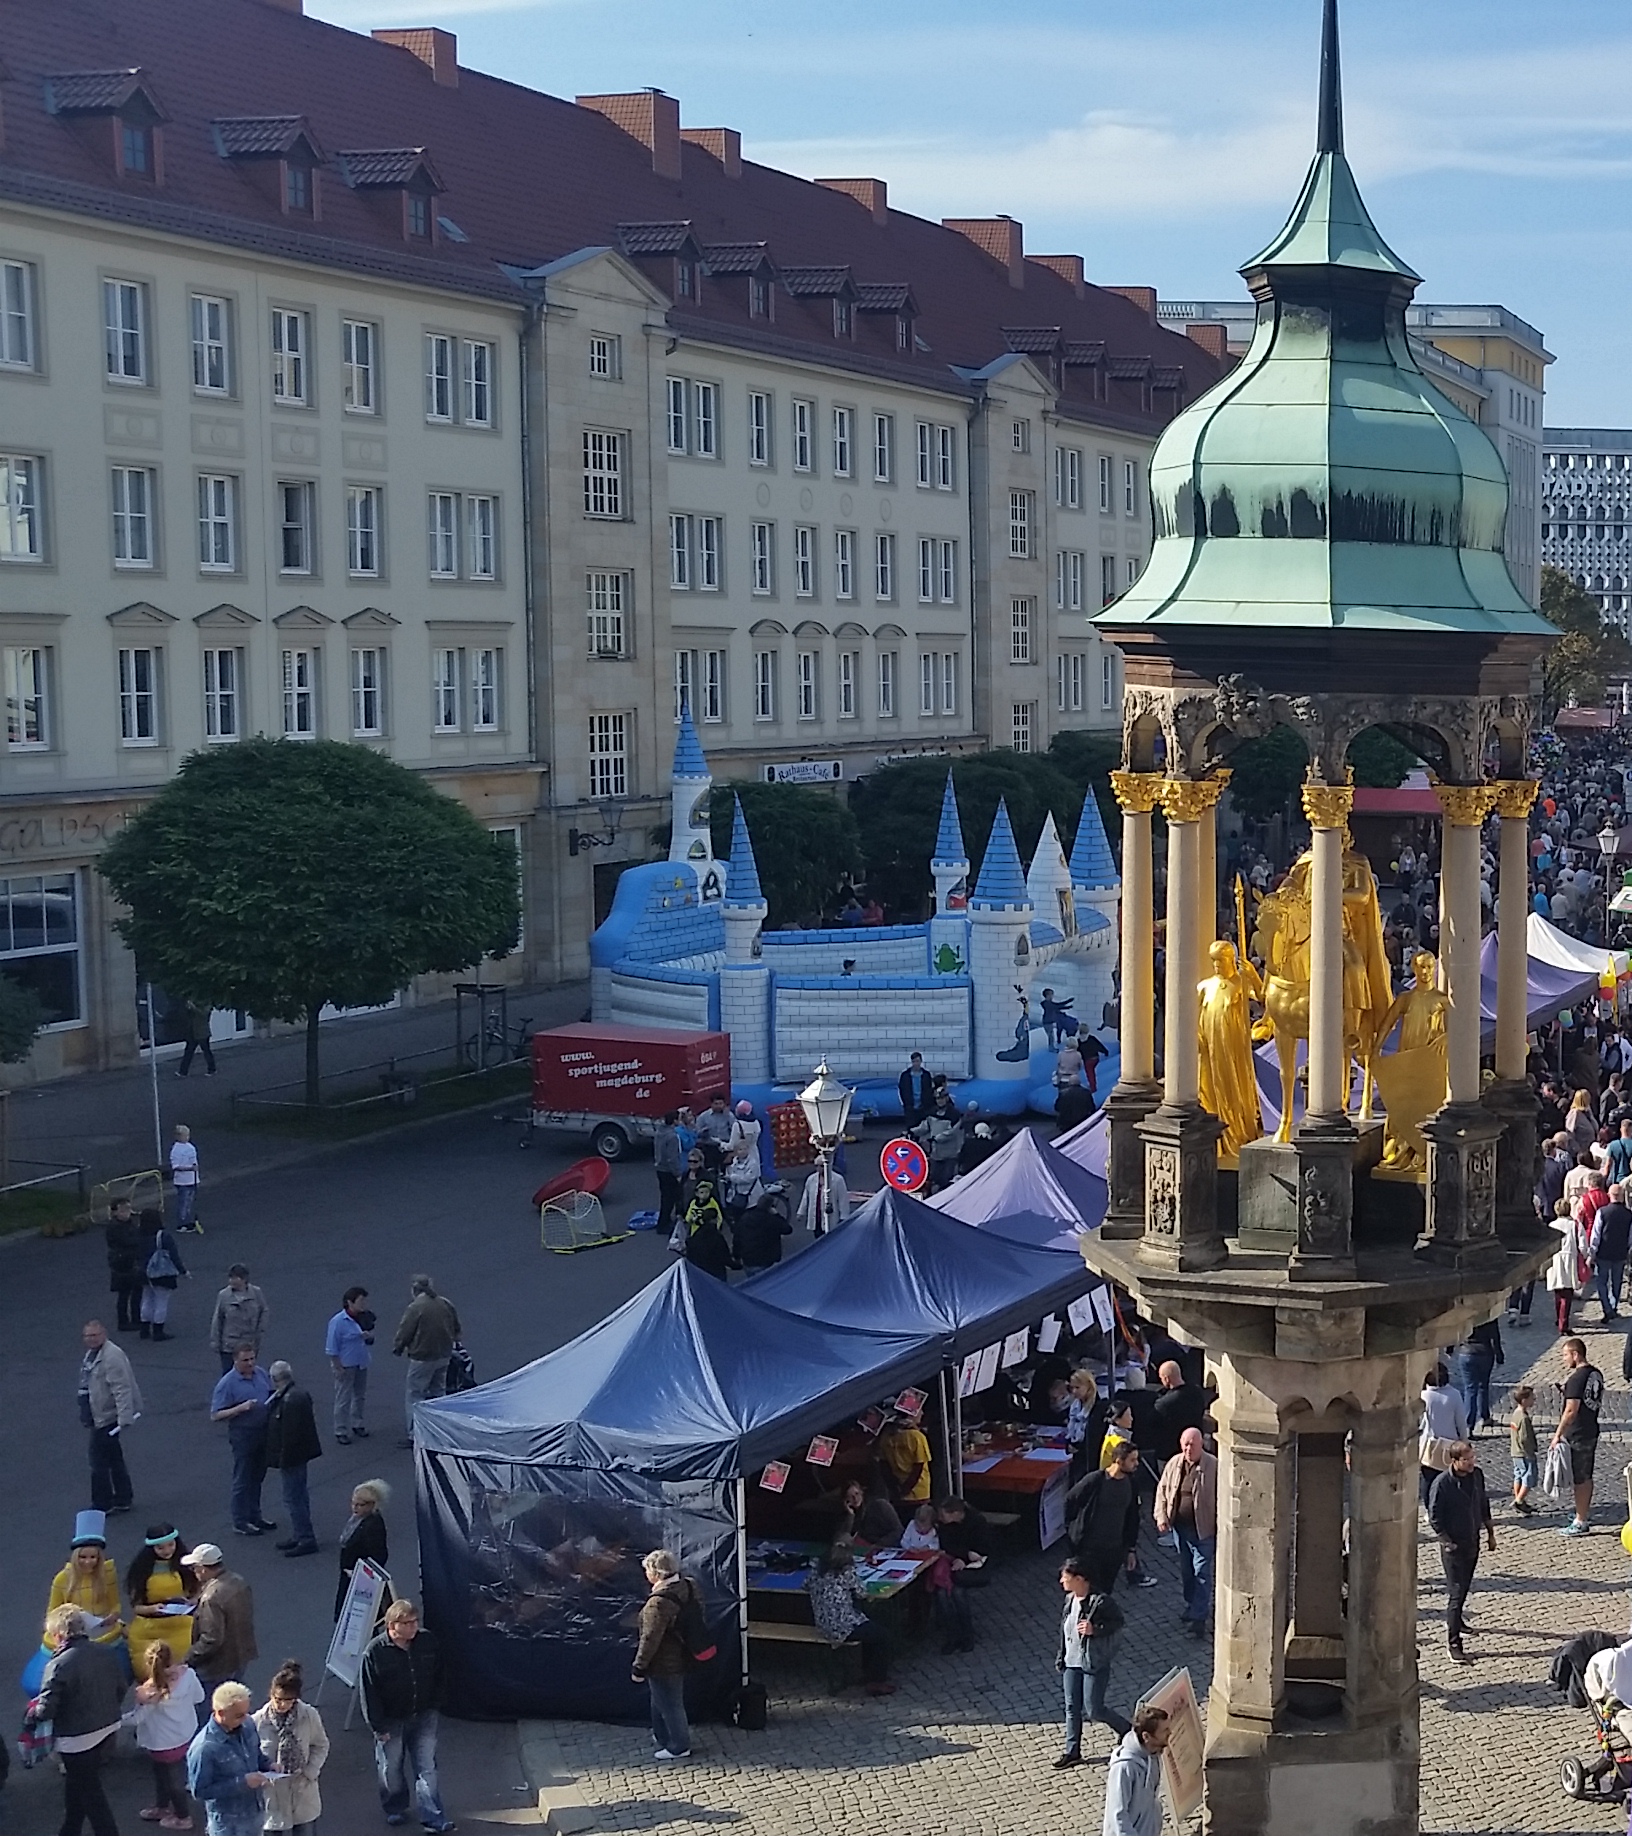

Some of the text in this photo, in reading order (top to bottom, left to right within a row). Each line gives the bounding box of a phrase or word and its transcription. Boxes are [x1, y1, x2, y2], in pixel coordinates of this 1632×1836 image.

[560, 1051, 595, 1062] www.
[568, 1058, 643, 1078] sportjugend-
[596, 1073, 666, 1088] magdeburg.
[635, 1087, 651, 1099] de
